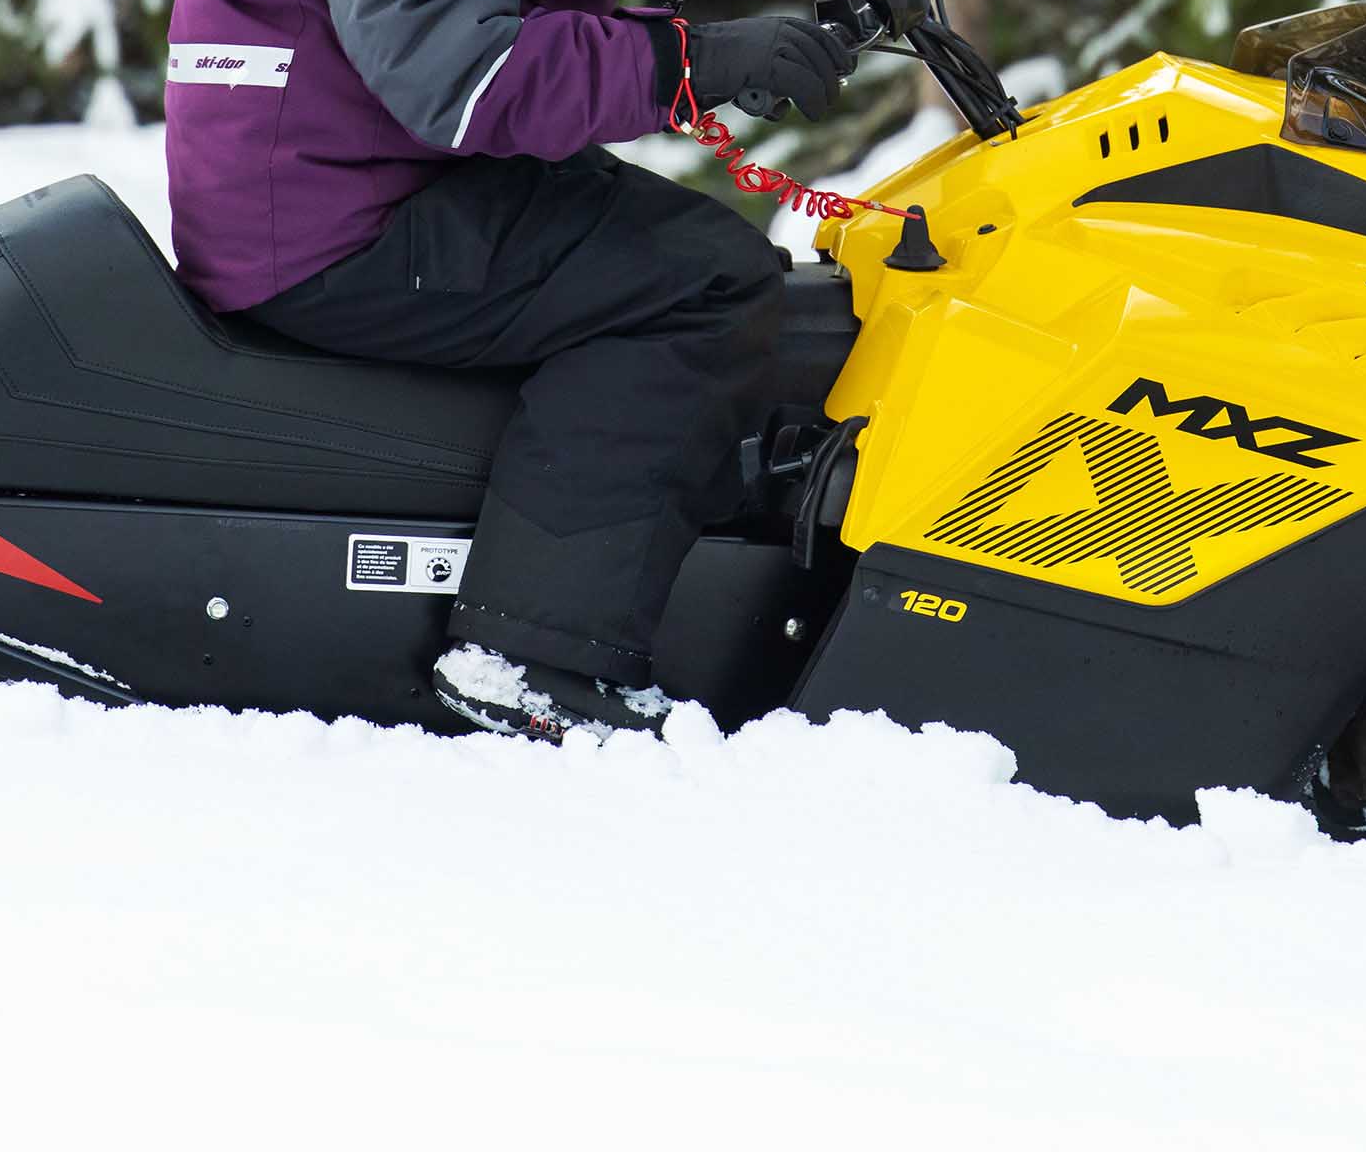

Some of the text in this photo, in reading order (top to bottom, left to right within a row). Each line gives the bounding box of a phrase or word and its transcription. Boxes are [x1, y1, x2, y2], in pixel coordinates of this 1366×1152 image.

[195, 56, 246, 69] ski-doo
[1105, 376, 1363, 469] MXZ
[420, 547, 458, 555] PROTOTYPE
[900, 590, 968, 623] 120
